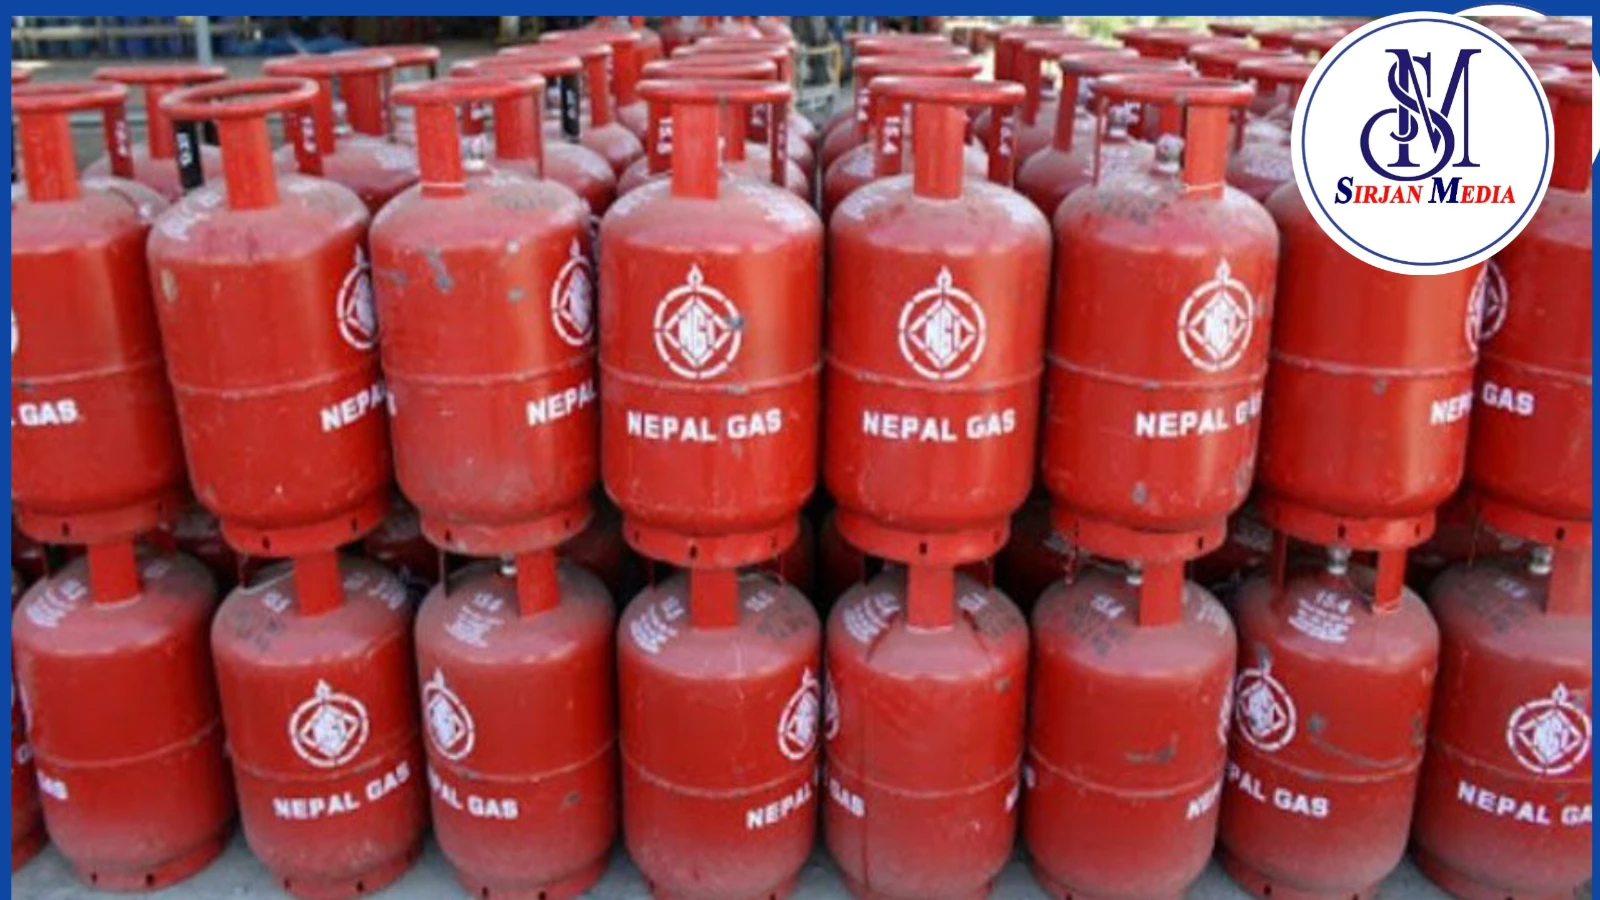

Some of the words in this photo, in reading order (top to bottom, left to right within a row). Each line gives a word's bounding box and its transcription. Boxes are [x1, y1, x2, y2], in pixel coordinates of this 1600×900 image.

[18, 398, 79, 426] GAS
[320, 383, 387, 433] NEPA
[1482, 382, 1535, 416] GAS
[626, 410, 718, 442] NEPAL
[726, 407, 783, 440] GAS
[862, 410, 959, 442] NEPAL
[965, 407, 1017, 440] GAS
[1135, 407, 1230, 438] NEPAL
[272, 791, 361, 820] NEPAL
[365, 760, 410, 801] GAS
[467, 795, 518, 820] GAS
[745, 782, 813, 830] NEPAL
[1273, 787, 1330, 819] GAS
[1457, 780, 1552, 826] NEPAL
[1561, 803, 1592, 826] GA
